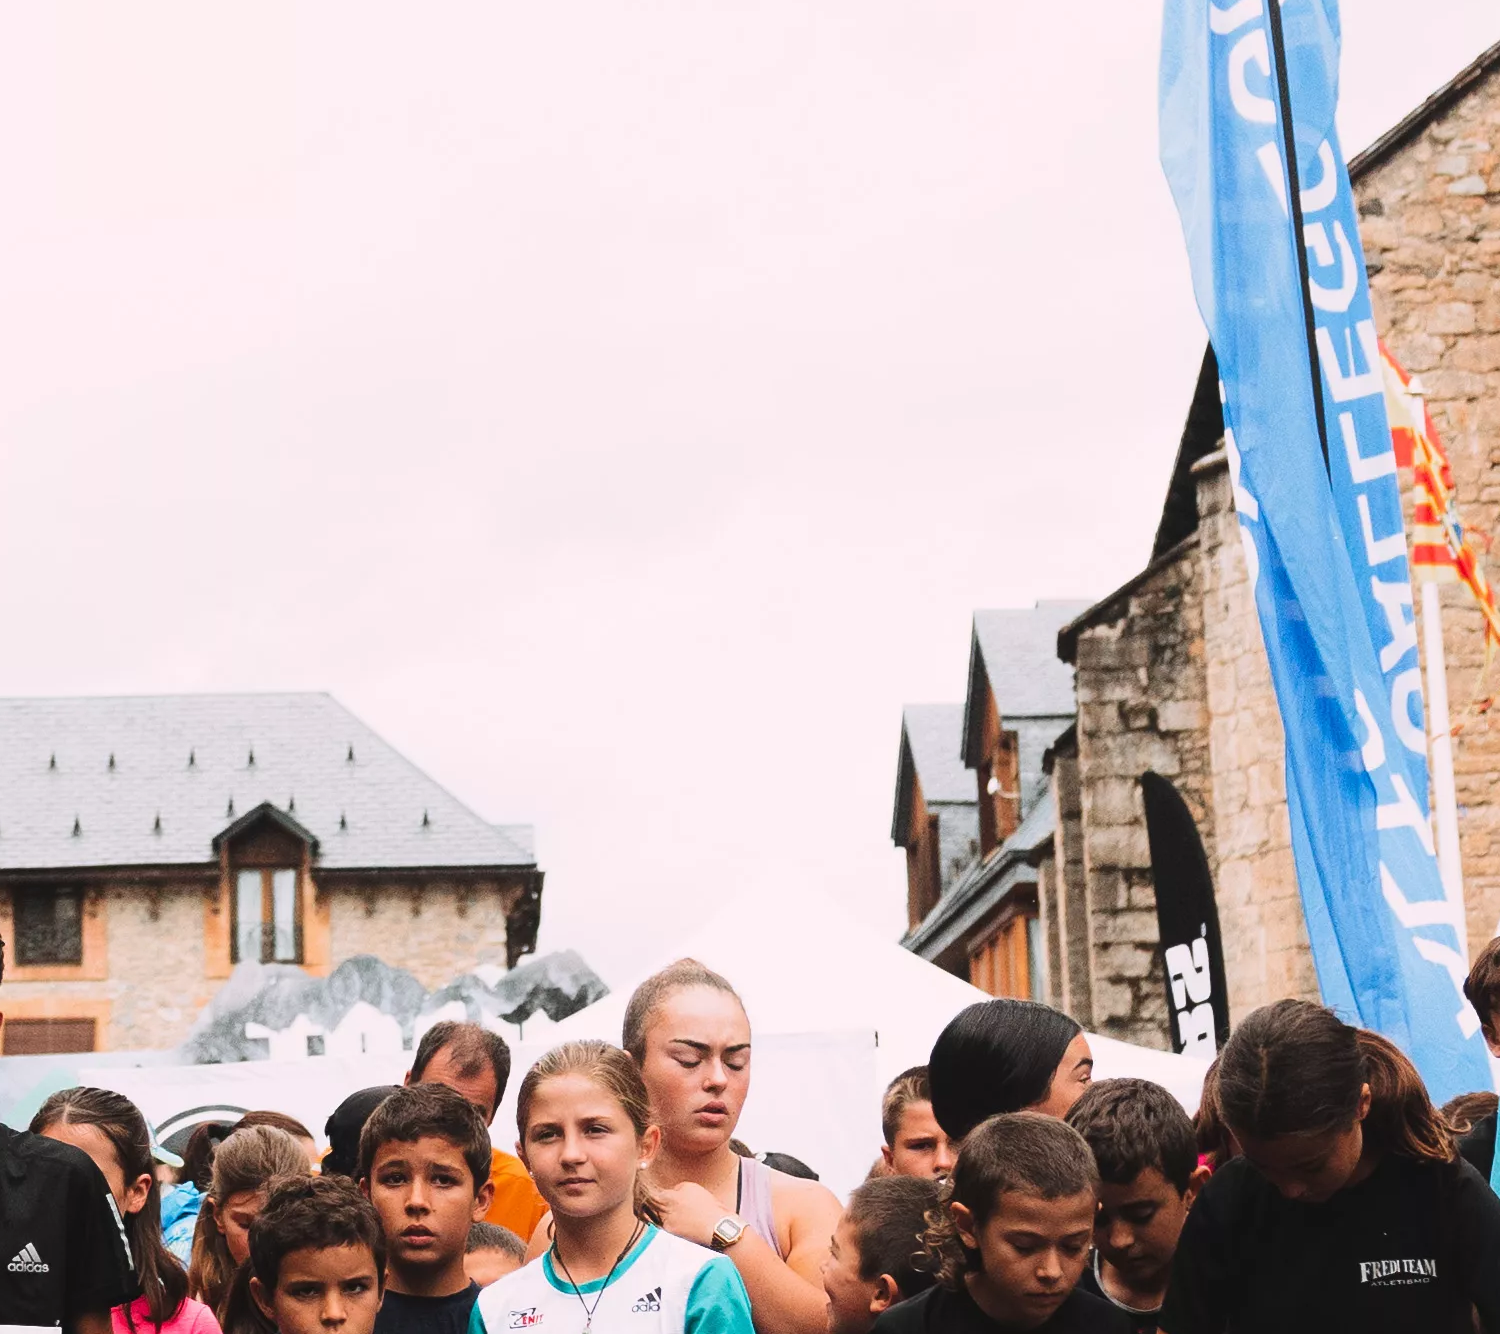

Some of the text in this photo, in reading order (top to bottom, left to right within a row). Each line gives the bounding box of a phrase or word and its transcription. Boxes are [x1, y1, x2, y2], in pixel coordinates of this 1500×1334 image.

[7, 1261, 50, 1273] adidas
[1359, 1258, 1437, 1283] FREDI TEAM
[1371, 1278, 1431, 1286] ATLETISMO
